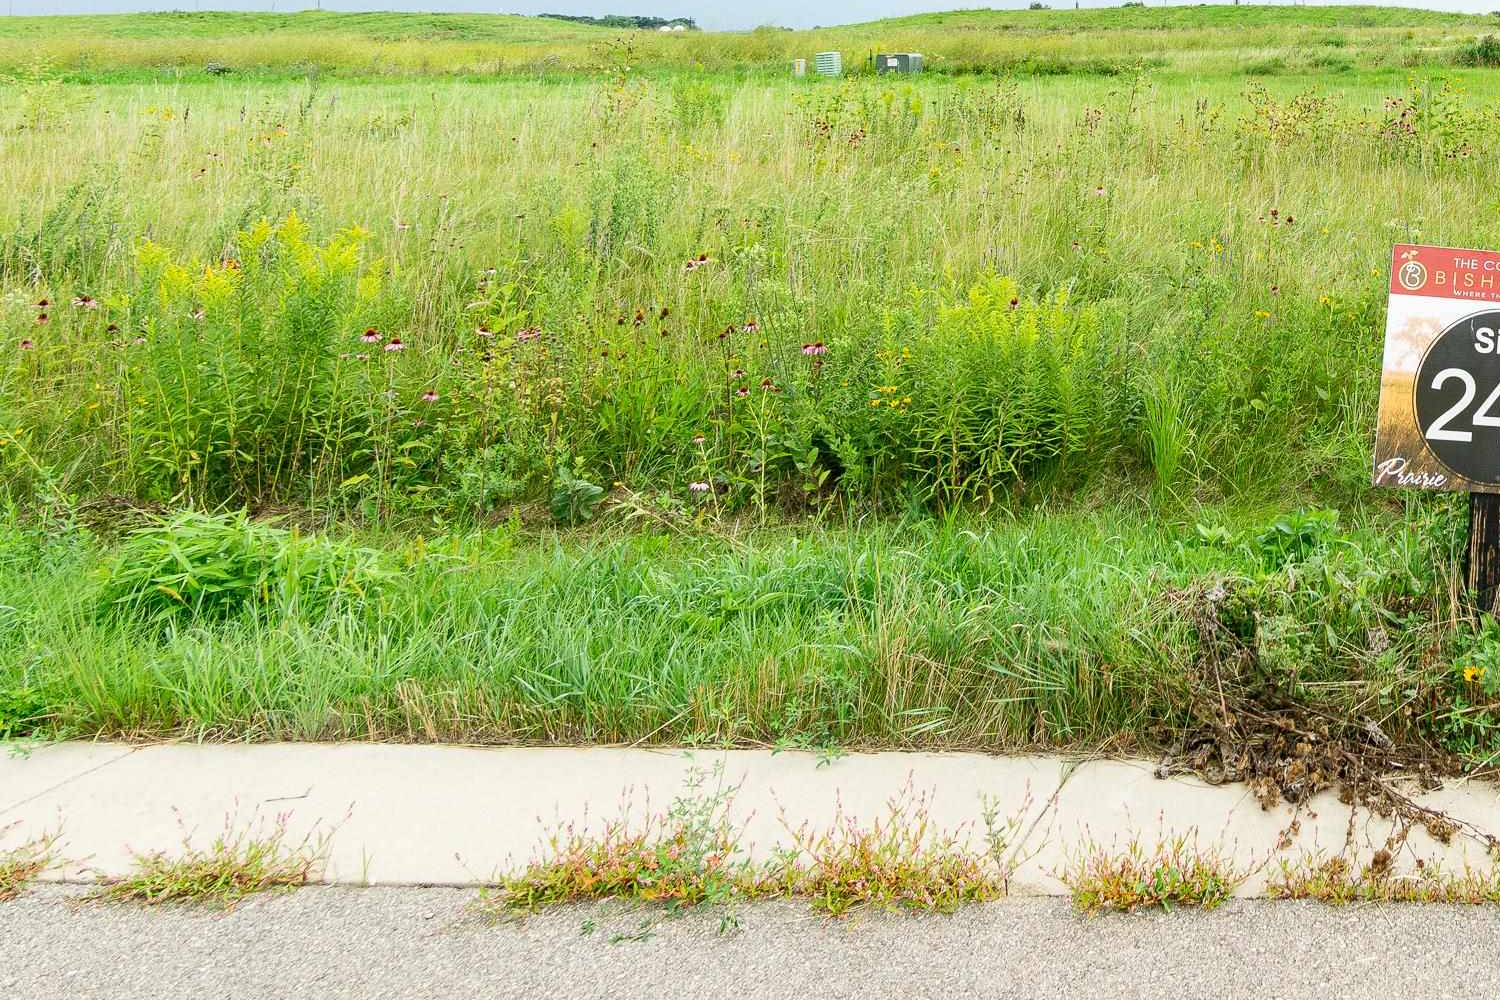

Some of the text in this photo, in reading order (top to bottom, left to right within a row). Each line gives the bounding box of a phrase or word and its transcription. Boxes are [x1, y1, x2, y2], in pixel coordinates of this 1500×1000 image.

[1453, 257, 1478, 270] THE
[1455, 290, 1485, 299] WHERE
[1375, 457, 1448, 488] Prairie
